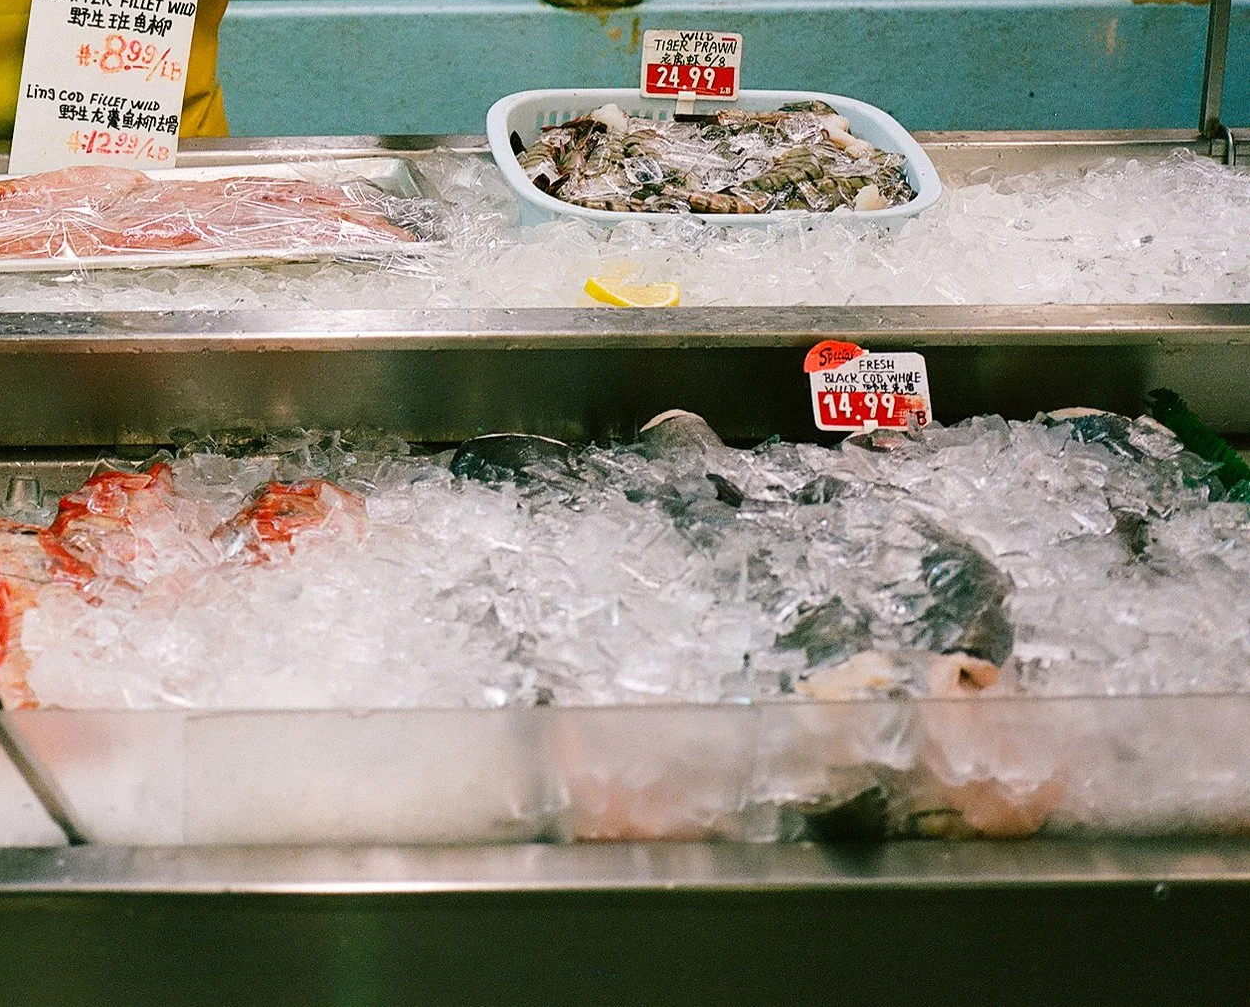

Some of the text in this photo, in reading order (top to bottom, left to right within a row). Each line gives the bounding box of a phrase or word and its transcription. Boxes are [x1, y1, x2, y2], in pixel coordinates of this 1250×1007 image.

[168, 0, 197, 17] WILD
[680, 32, 715, 42] WILD
[694, 40, 738, 55] PRAWN
[655, 66, 716, 90] 24.99
[58, 90, 85, 103] COD
[131, 99, 161, 112] WILD
[858, 359, 895, 370] FRESH
[823, 371, 922, 384] BLACK COD WHOLE
[822, 393, 896, 421] 14.99
